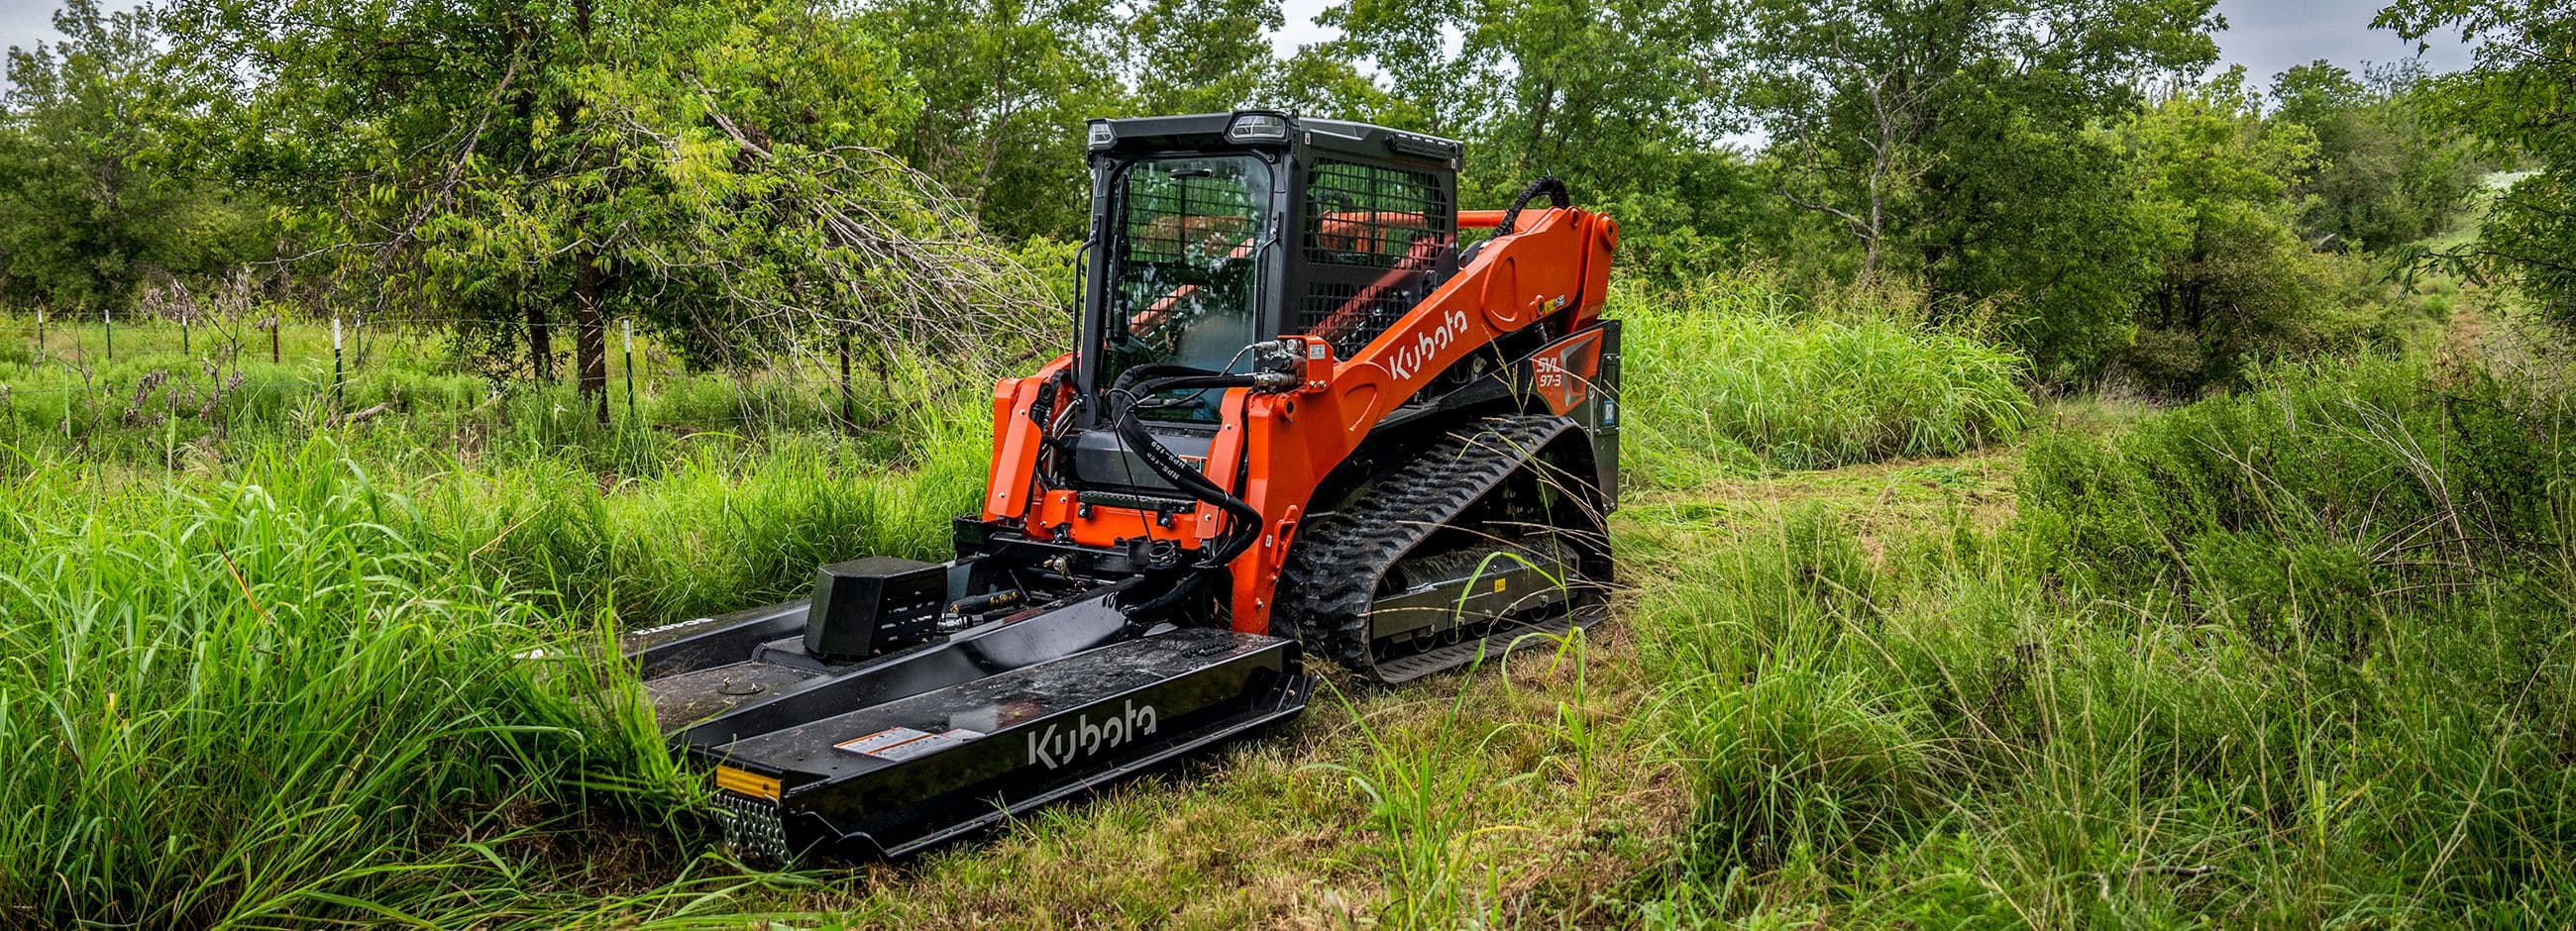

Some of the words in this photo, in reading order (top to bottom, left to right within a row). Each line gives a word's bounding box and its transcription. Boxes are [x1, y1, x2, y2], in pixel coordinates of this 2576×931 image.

[1389, 310, 1467, 380] Kubota
[1536, 357, 1561, 373] SVL
[1539, 374, 1561, 387] 97-3
[1027, 699, 1157, 770] Kubota
